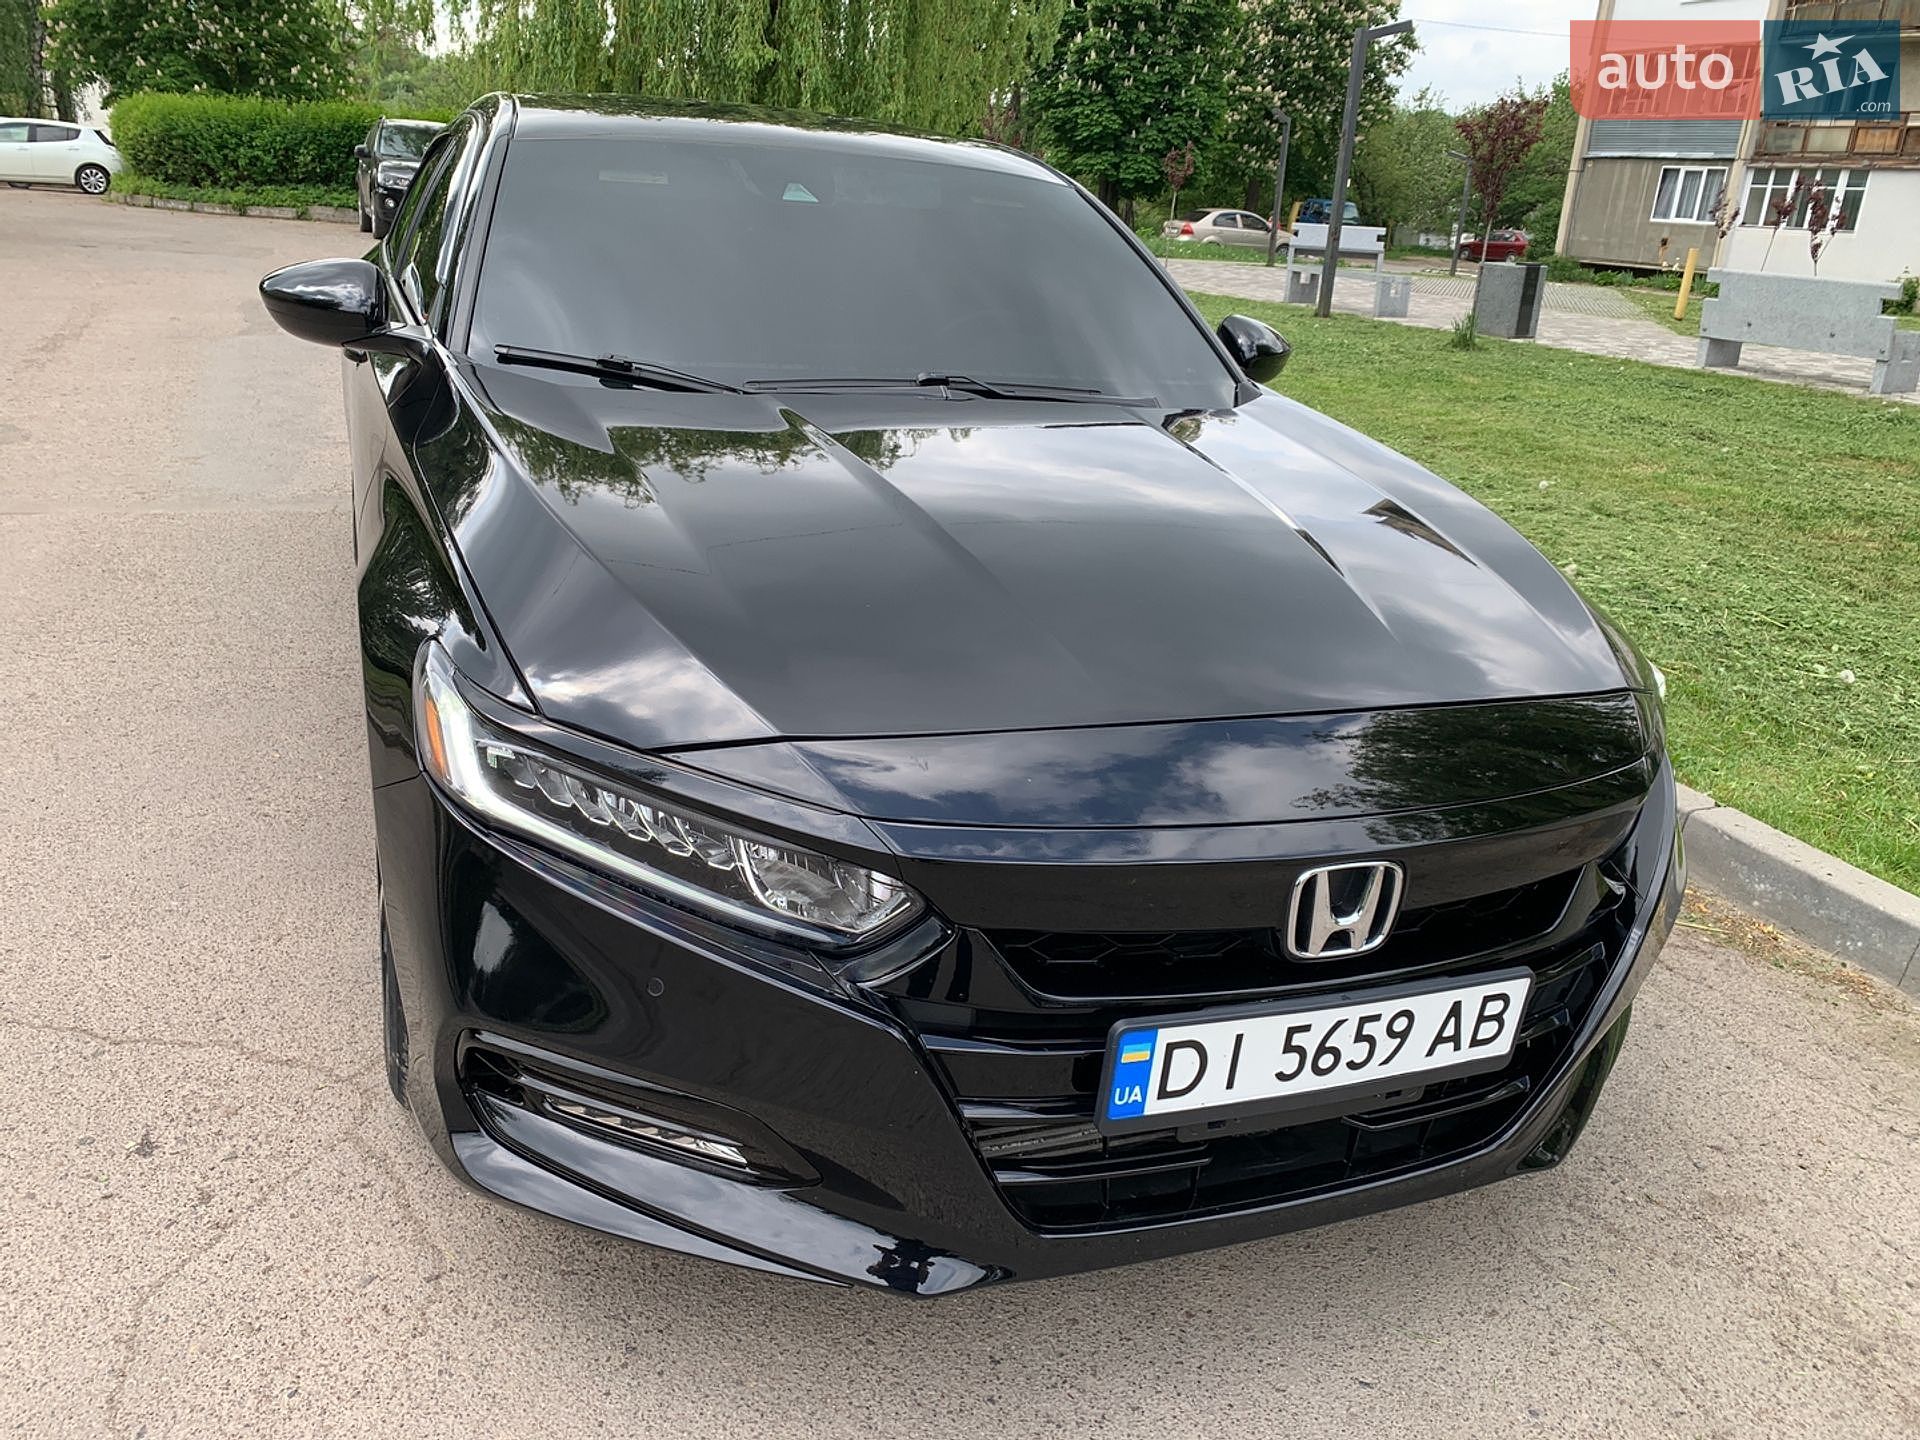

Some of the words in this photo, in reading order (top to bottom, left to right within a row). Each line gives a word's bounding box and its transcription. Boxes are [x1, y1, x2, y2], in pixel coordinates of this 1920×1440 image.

[1156, 1033, 1244, 1100] DI
[1274, 1009, 1415, 1082] 5659
[1424, 993, 1511, 1057] AB
[1114, 1087, 1143, 1105] UA
